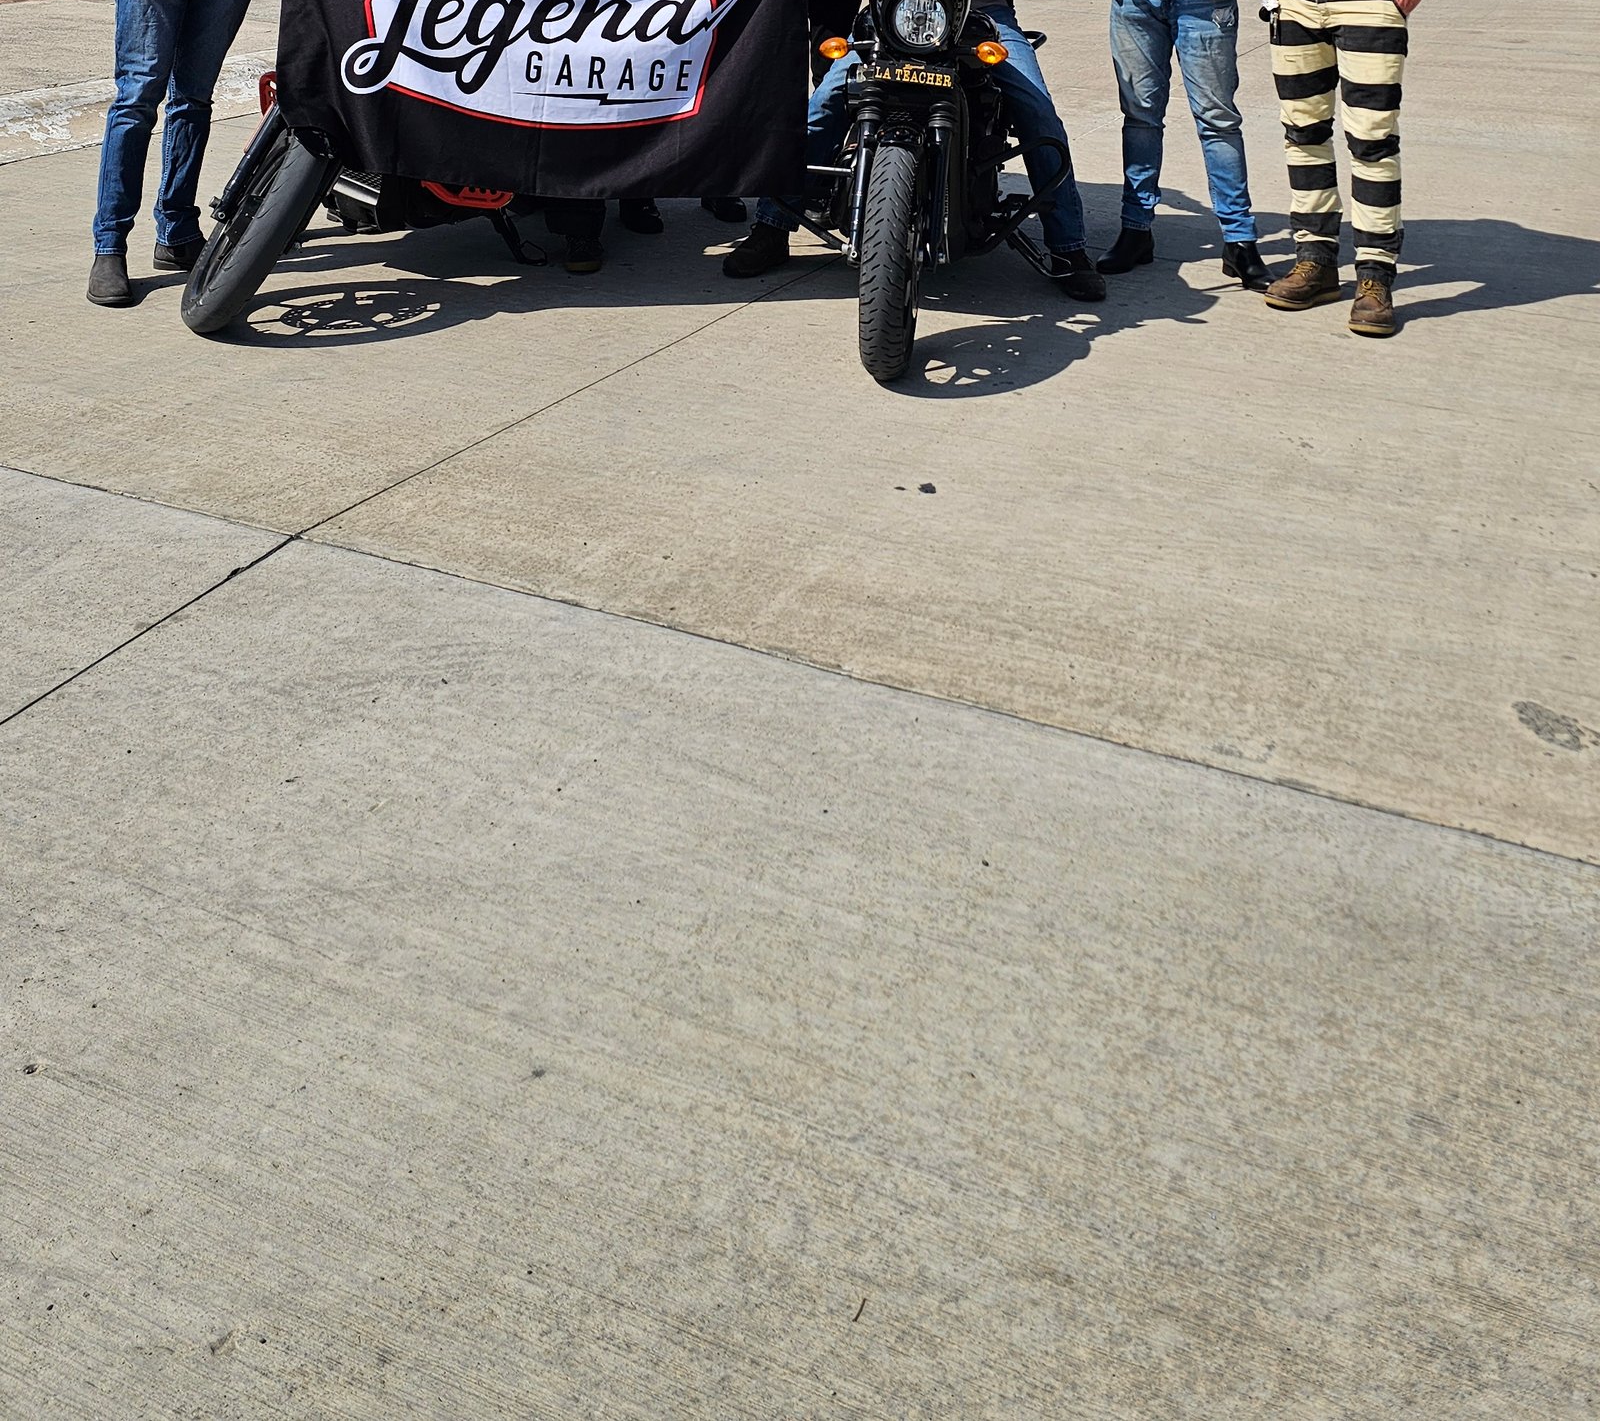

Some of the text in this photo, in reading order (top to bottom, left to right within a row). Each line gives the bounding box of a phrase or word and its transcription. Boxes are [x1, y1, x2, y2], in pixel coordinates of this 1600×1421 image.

[525, 50, 693, 92] GARAGE
[874, 66, 891, 80] LA
[895, 68, 952, 87] TEACHER
